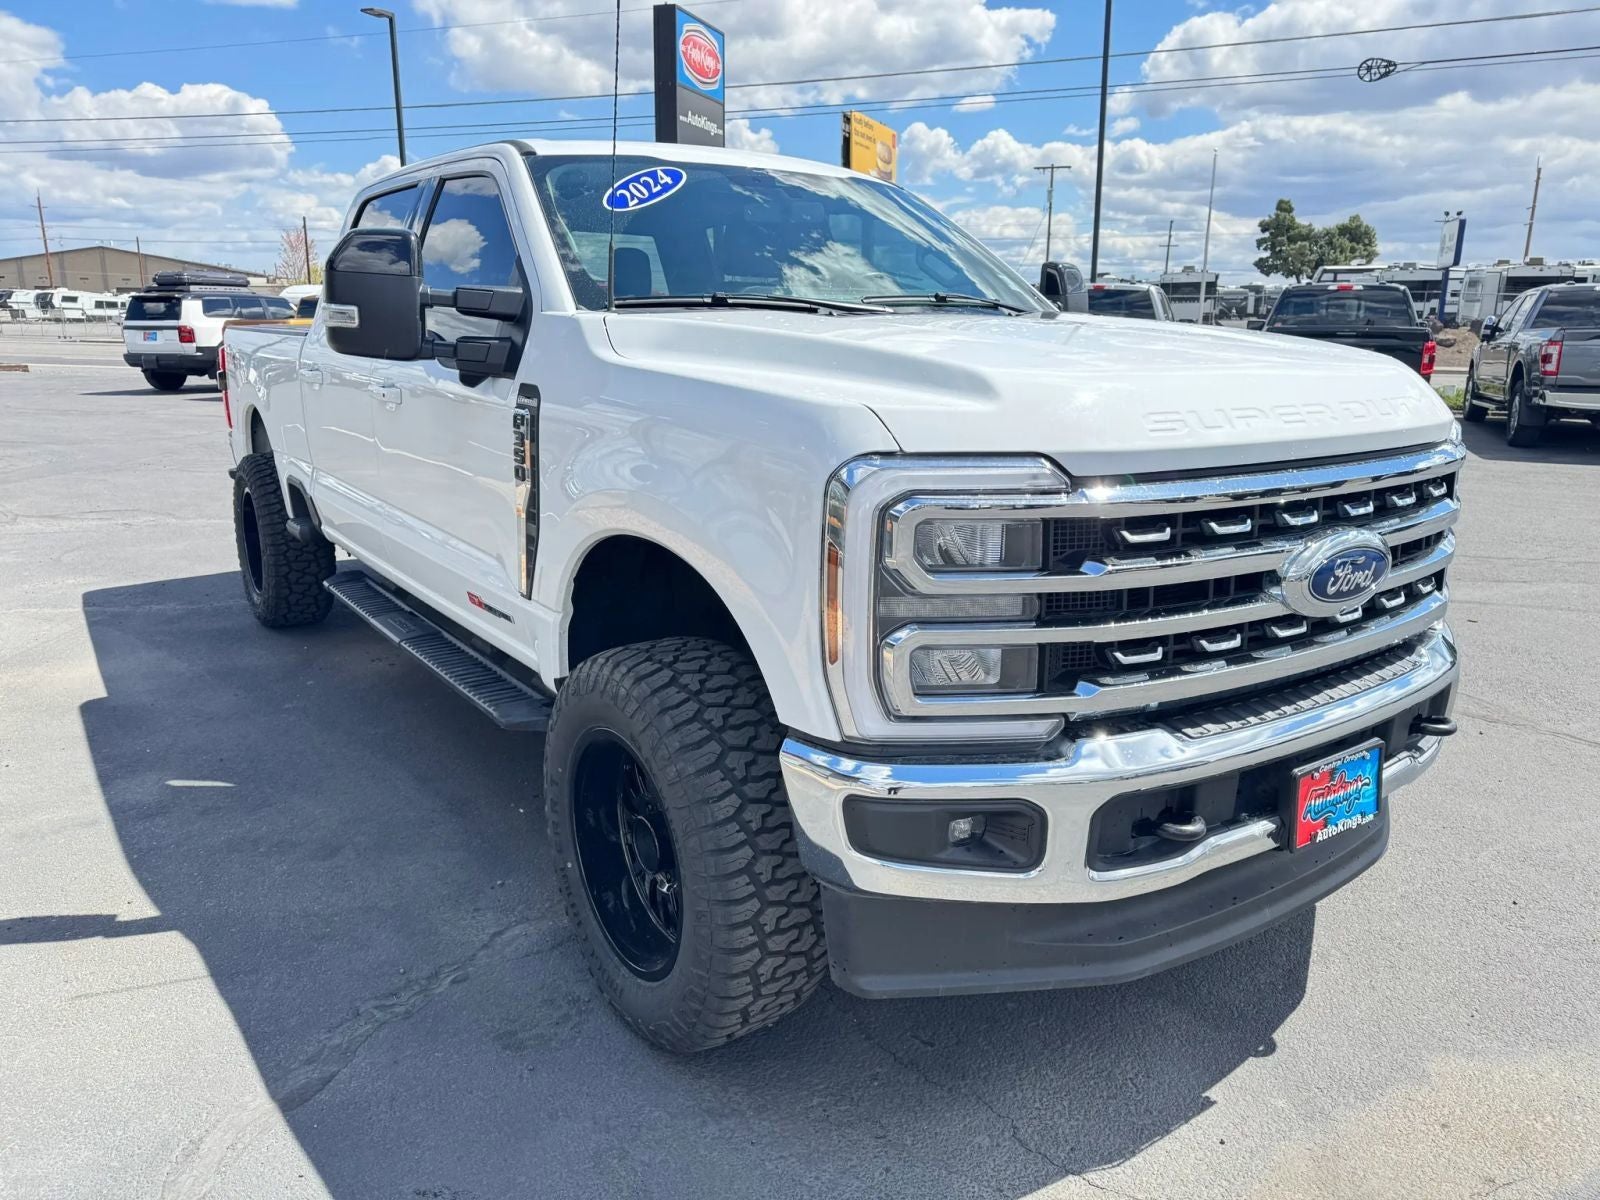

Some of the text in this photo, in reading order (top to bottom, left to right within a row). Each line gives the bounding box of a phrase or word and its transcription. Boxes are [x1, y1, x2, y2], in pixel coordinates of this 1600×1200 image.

[616, 168, 674, 207] 2024
[1142, 402, 1340, 437] SUPER
[1326, 555, 1377, 596] Ford
[1319, 757, 1343, 773] Central
[1316, 813, 1374, 843] AutoKings.com
